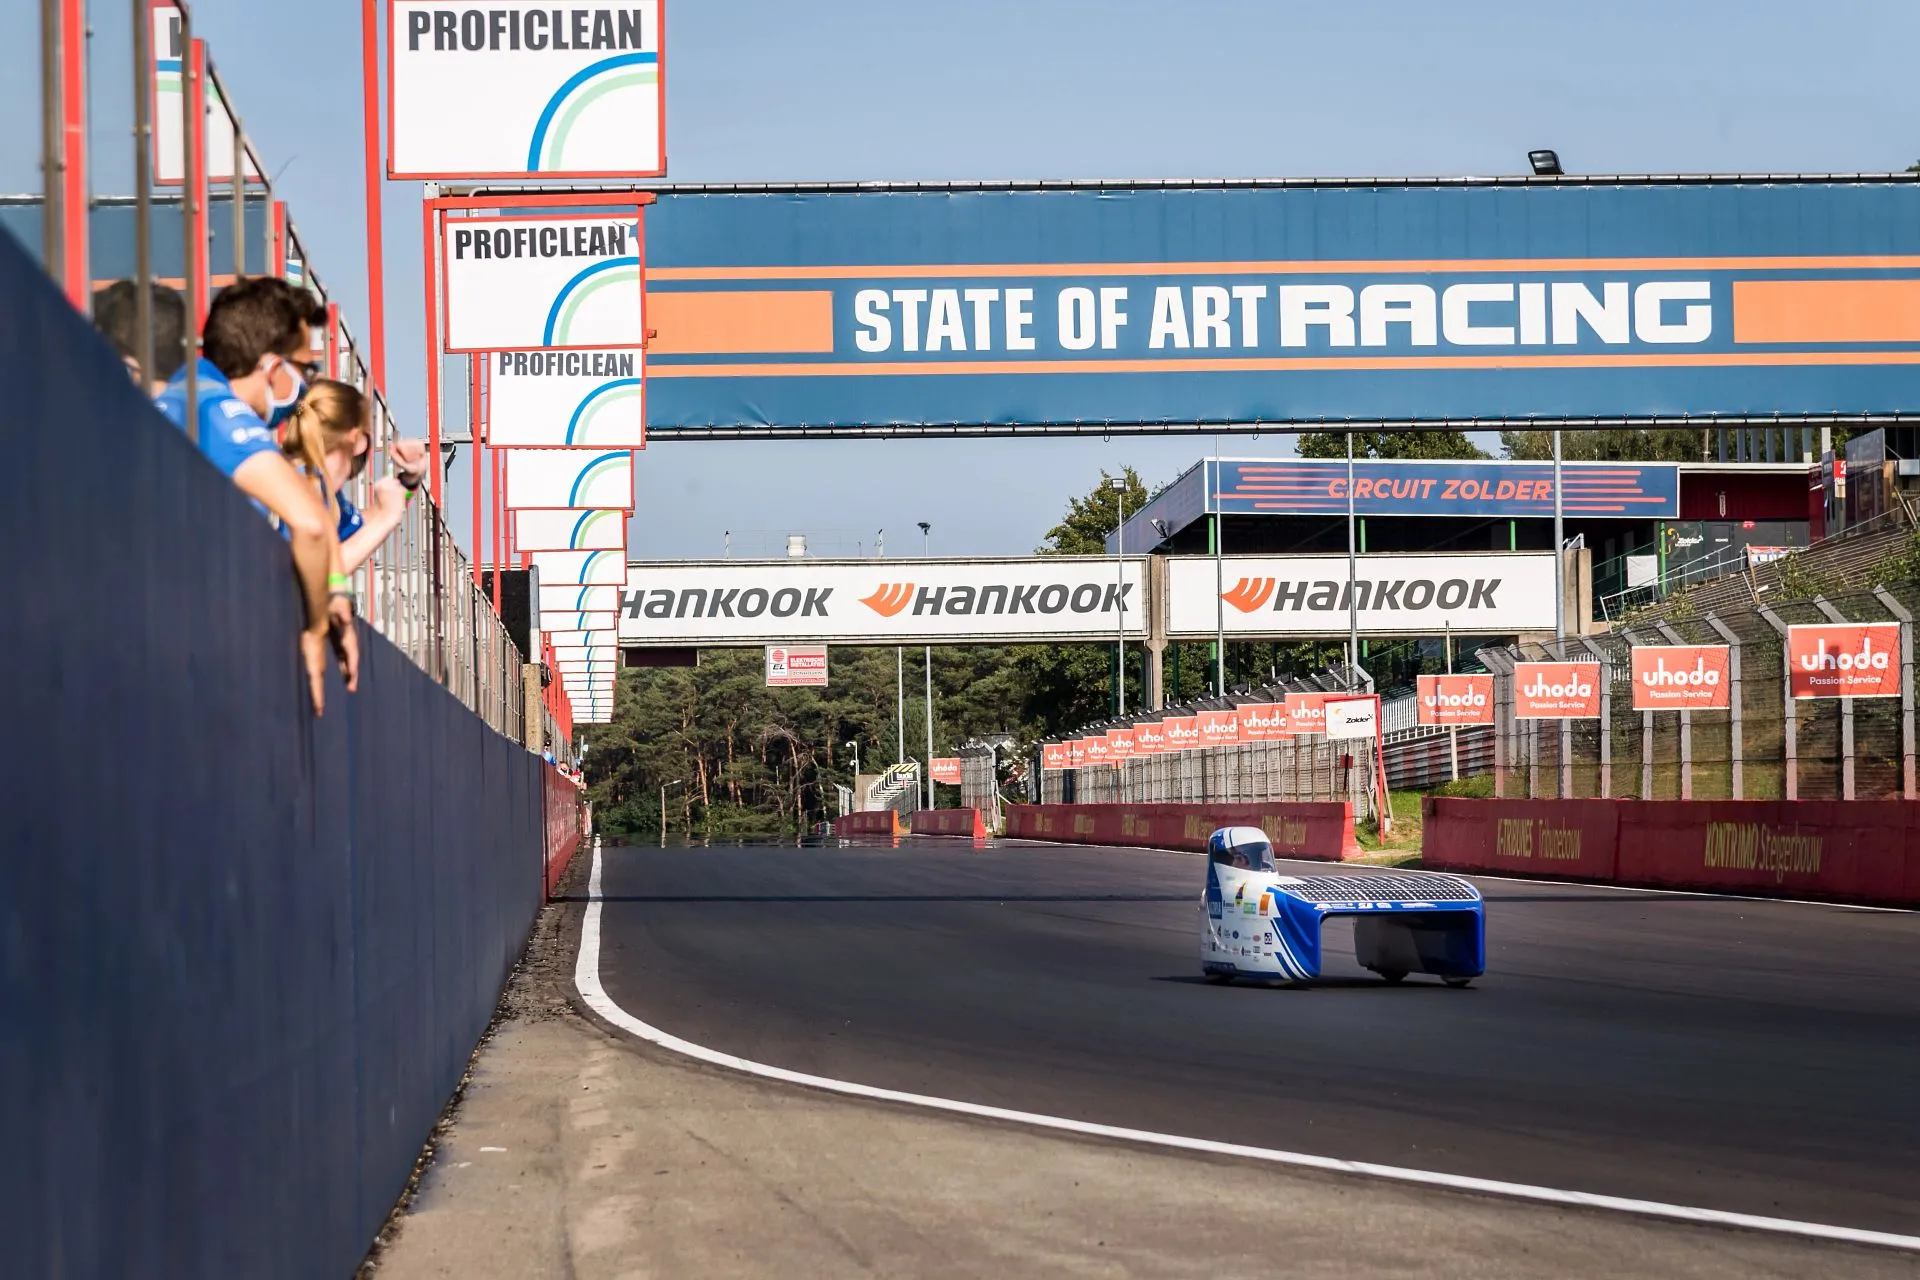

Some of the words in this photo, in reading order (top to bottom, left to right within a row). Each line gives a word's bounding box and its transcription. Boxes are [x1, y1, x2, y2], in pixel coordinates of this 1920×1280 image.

[408, 9, 642, 51] PROFICLEAN
[455, 226, 626, 260] PROFICLEAN
[854, 288, 1036, 353] STATE
[1057, 287, 1128, 350] OF
[1149, 286, 1267, 348] ART
[1279, 281, 1713, 347] RACING
[499, 352, 634, 377] PROFICLEAN
[1440, 480, 1551, 500] ZOLDER
[1801, 637, 1889, 671] uhoda
[1643, 657, 1719, 686] uhoda
[1809, 676, 1845, 685] Passion
[1847, 675, 1882, 684] Service
[1523, 672, 1591, 697] uhoda
[1650, 690, 1681, 698] Passion
[1683, 690, 1713, 698] Service
[1424, 684, 1486, 706] uhoda
[1291, 700, 1325, 719] uho
[1168, 722, 1198, 738] uhod
[1203, 717, 1238, 733] uhod
[1111, 735, 1134, 748] uho
[1138, 728, 1163, 743] uho
[1066, 745, 1084, 757] uho
[1088, 741, 1107, 754] uho
[1704, 822, 1759, 870] KONTRIMO
